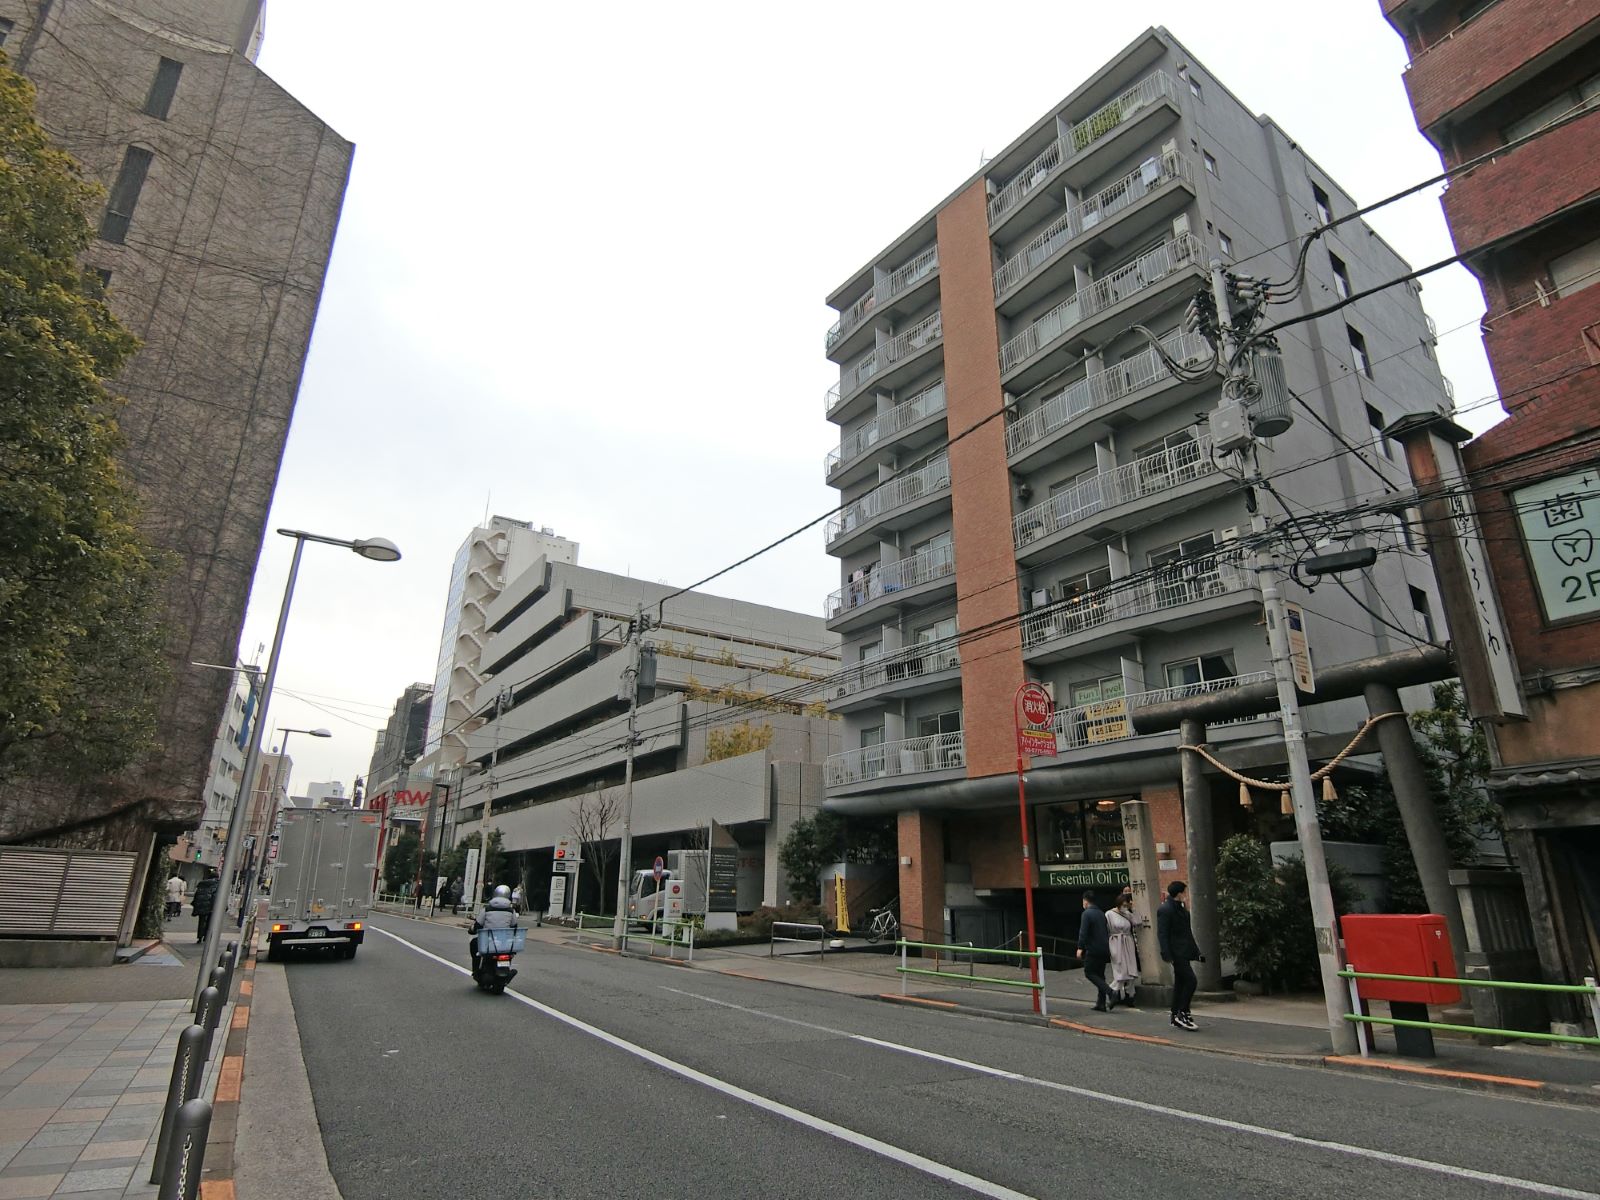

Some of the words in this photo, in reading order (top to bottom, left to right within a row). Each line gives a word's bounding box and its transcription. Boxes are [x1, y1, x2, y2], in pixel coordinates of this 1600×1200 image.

[1561, 569, 1600, 603] 2F
[1024, 699, 1047, 716] 消火栓
[1049, 871, 1094, 886] Essential
[1096, 870, 1112, 885] Oil
